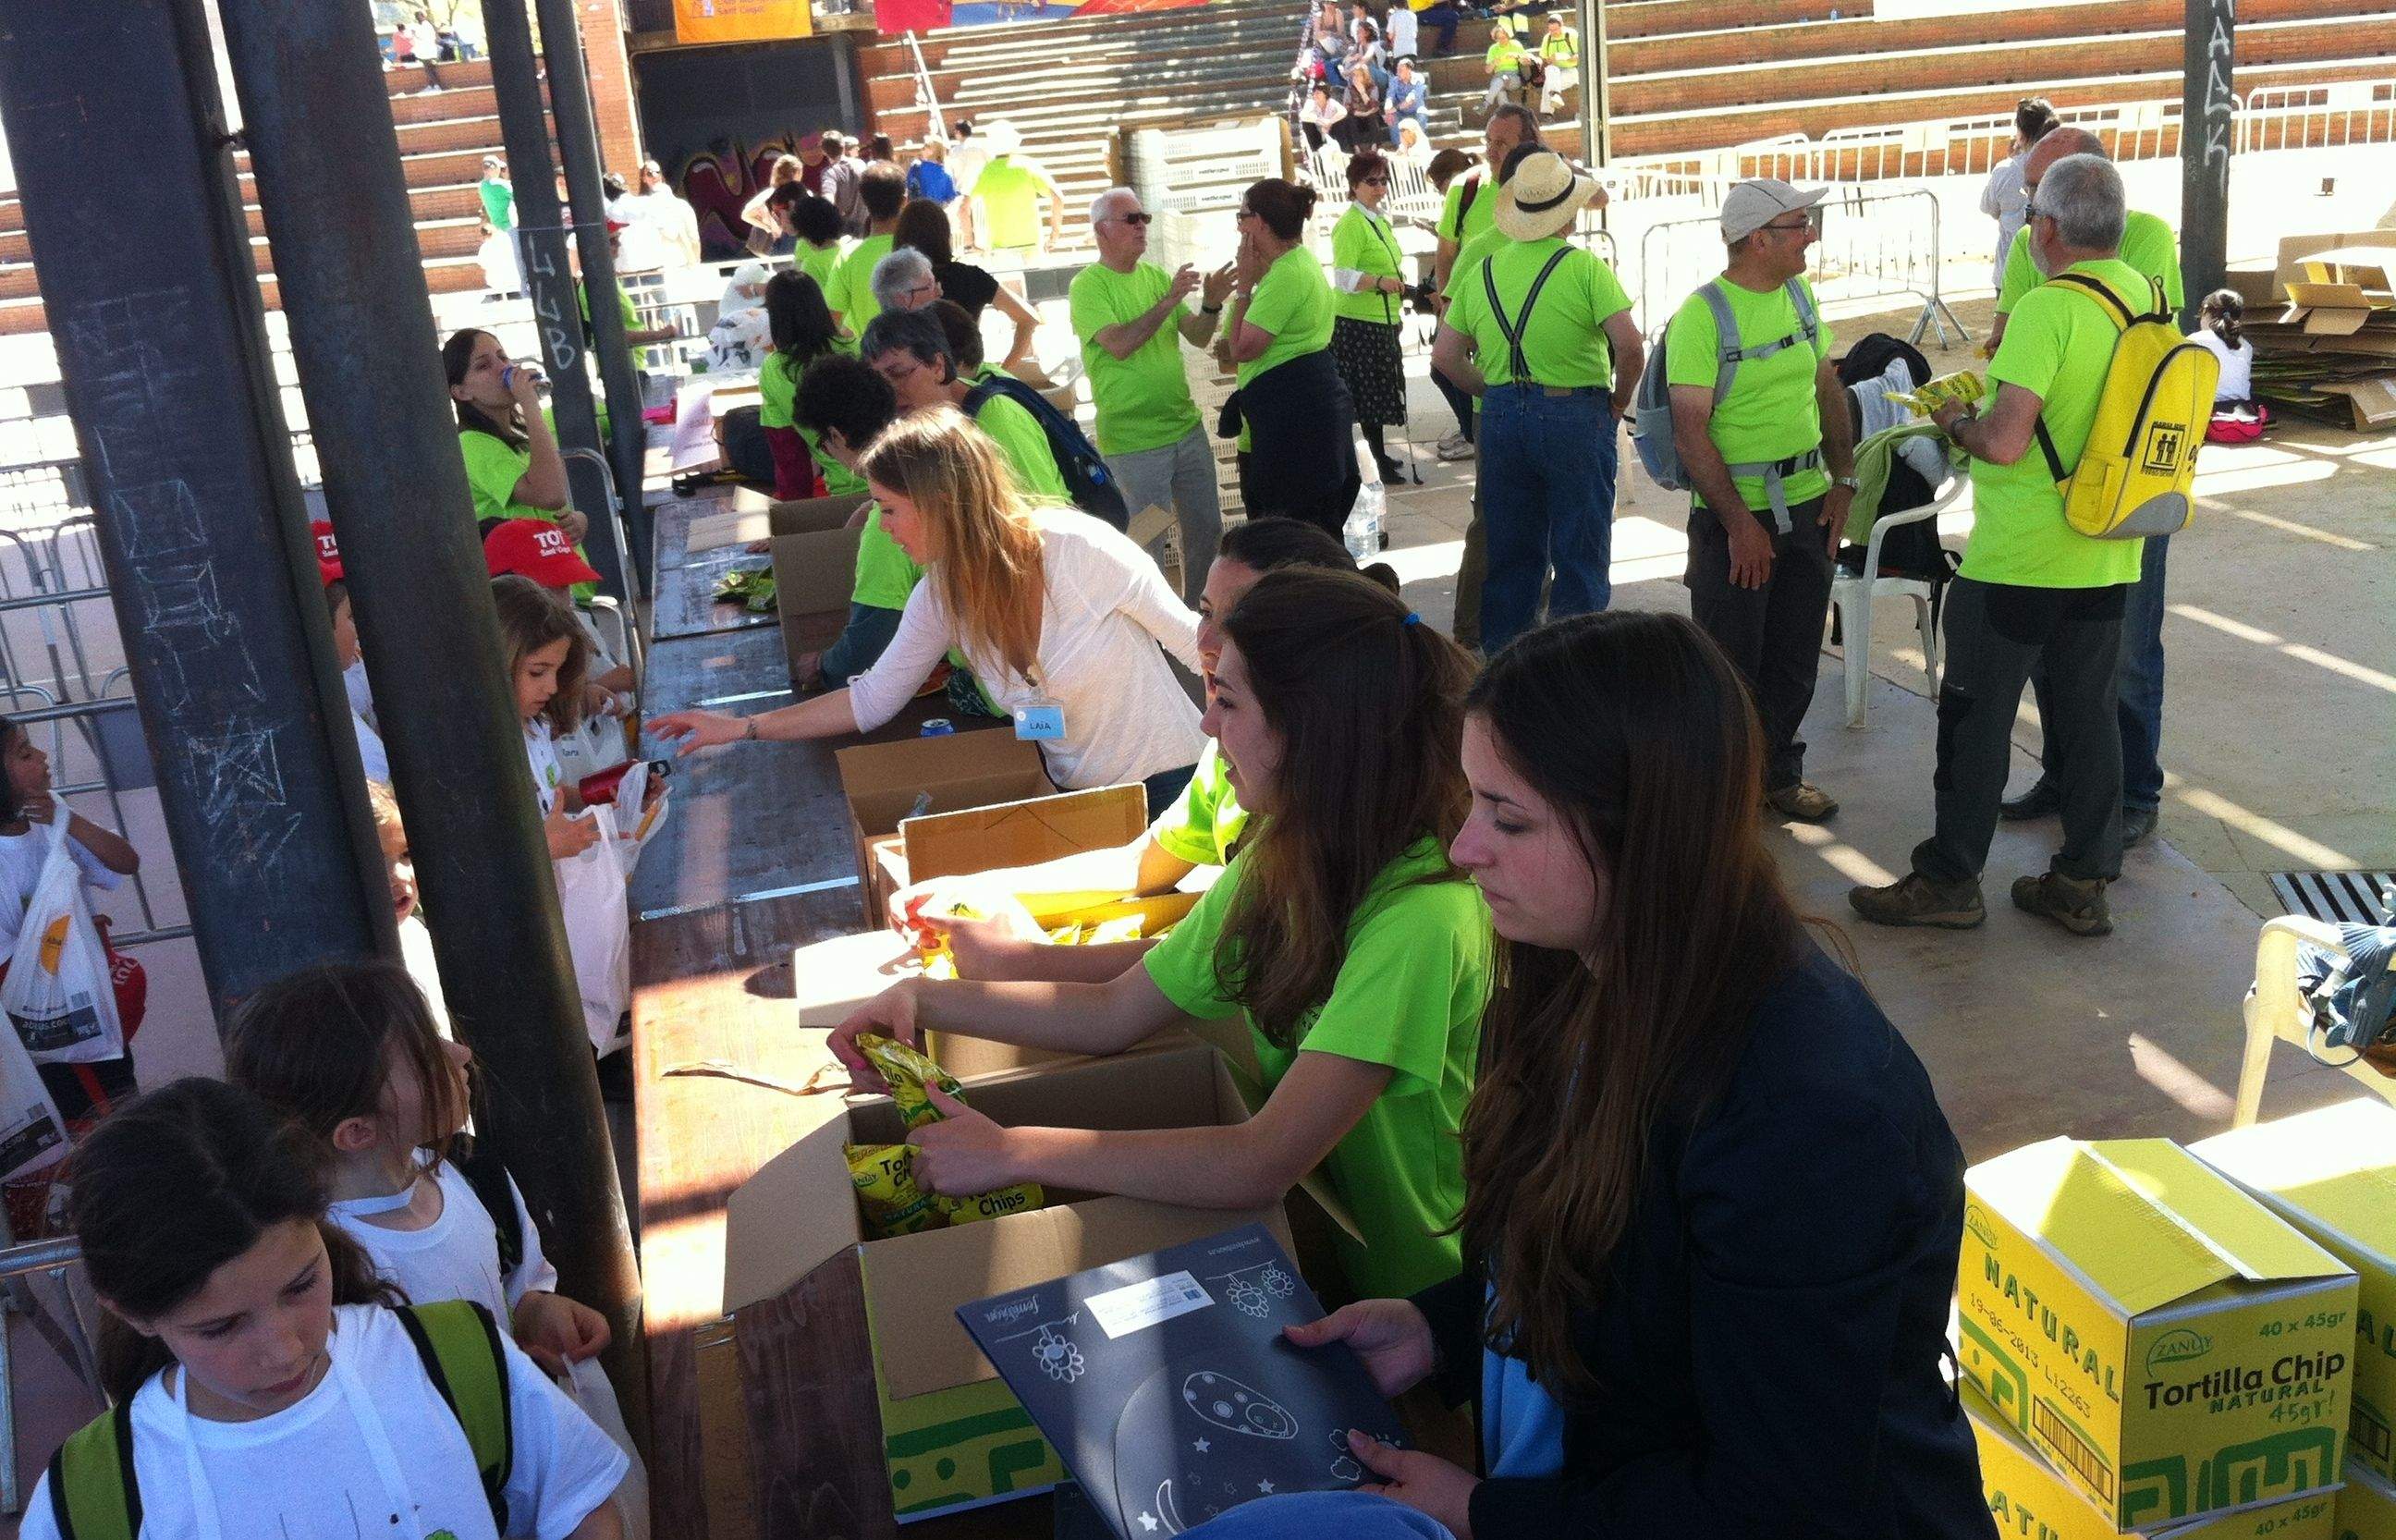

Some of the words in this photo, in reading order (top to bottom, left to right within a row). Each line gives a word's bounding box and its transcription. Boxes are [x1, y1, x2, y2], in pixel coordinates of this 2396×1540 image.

[978, 1191, 1026, 1216] Chips
[1970, 1293, 2039, 1368] 19-06-2013
[1985, 1252, 2120, 1404] NATURAL
[2259, 1321, 2282, 1338] 40
[2288, 1322, 2299, 1333] x
[2304, 1312, 2346, 1329] 45gr
[2144, 1366, 2263, 1411] Tortilla
[2271, 1351, 2345, 1385] Chip
[2209, 1378, 2324, 1414] NATURAL
